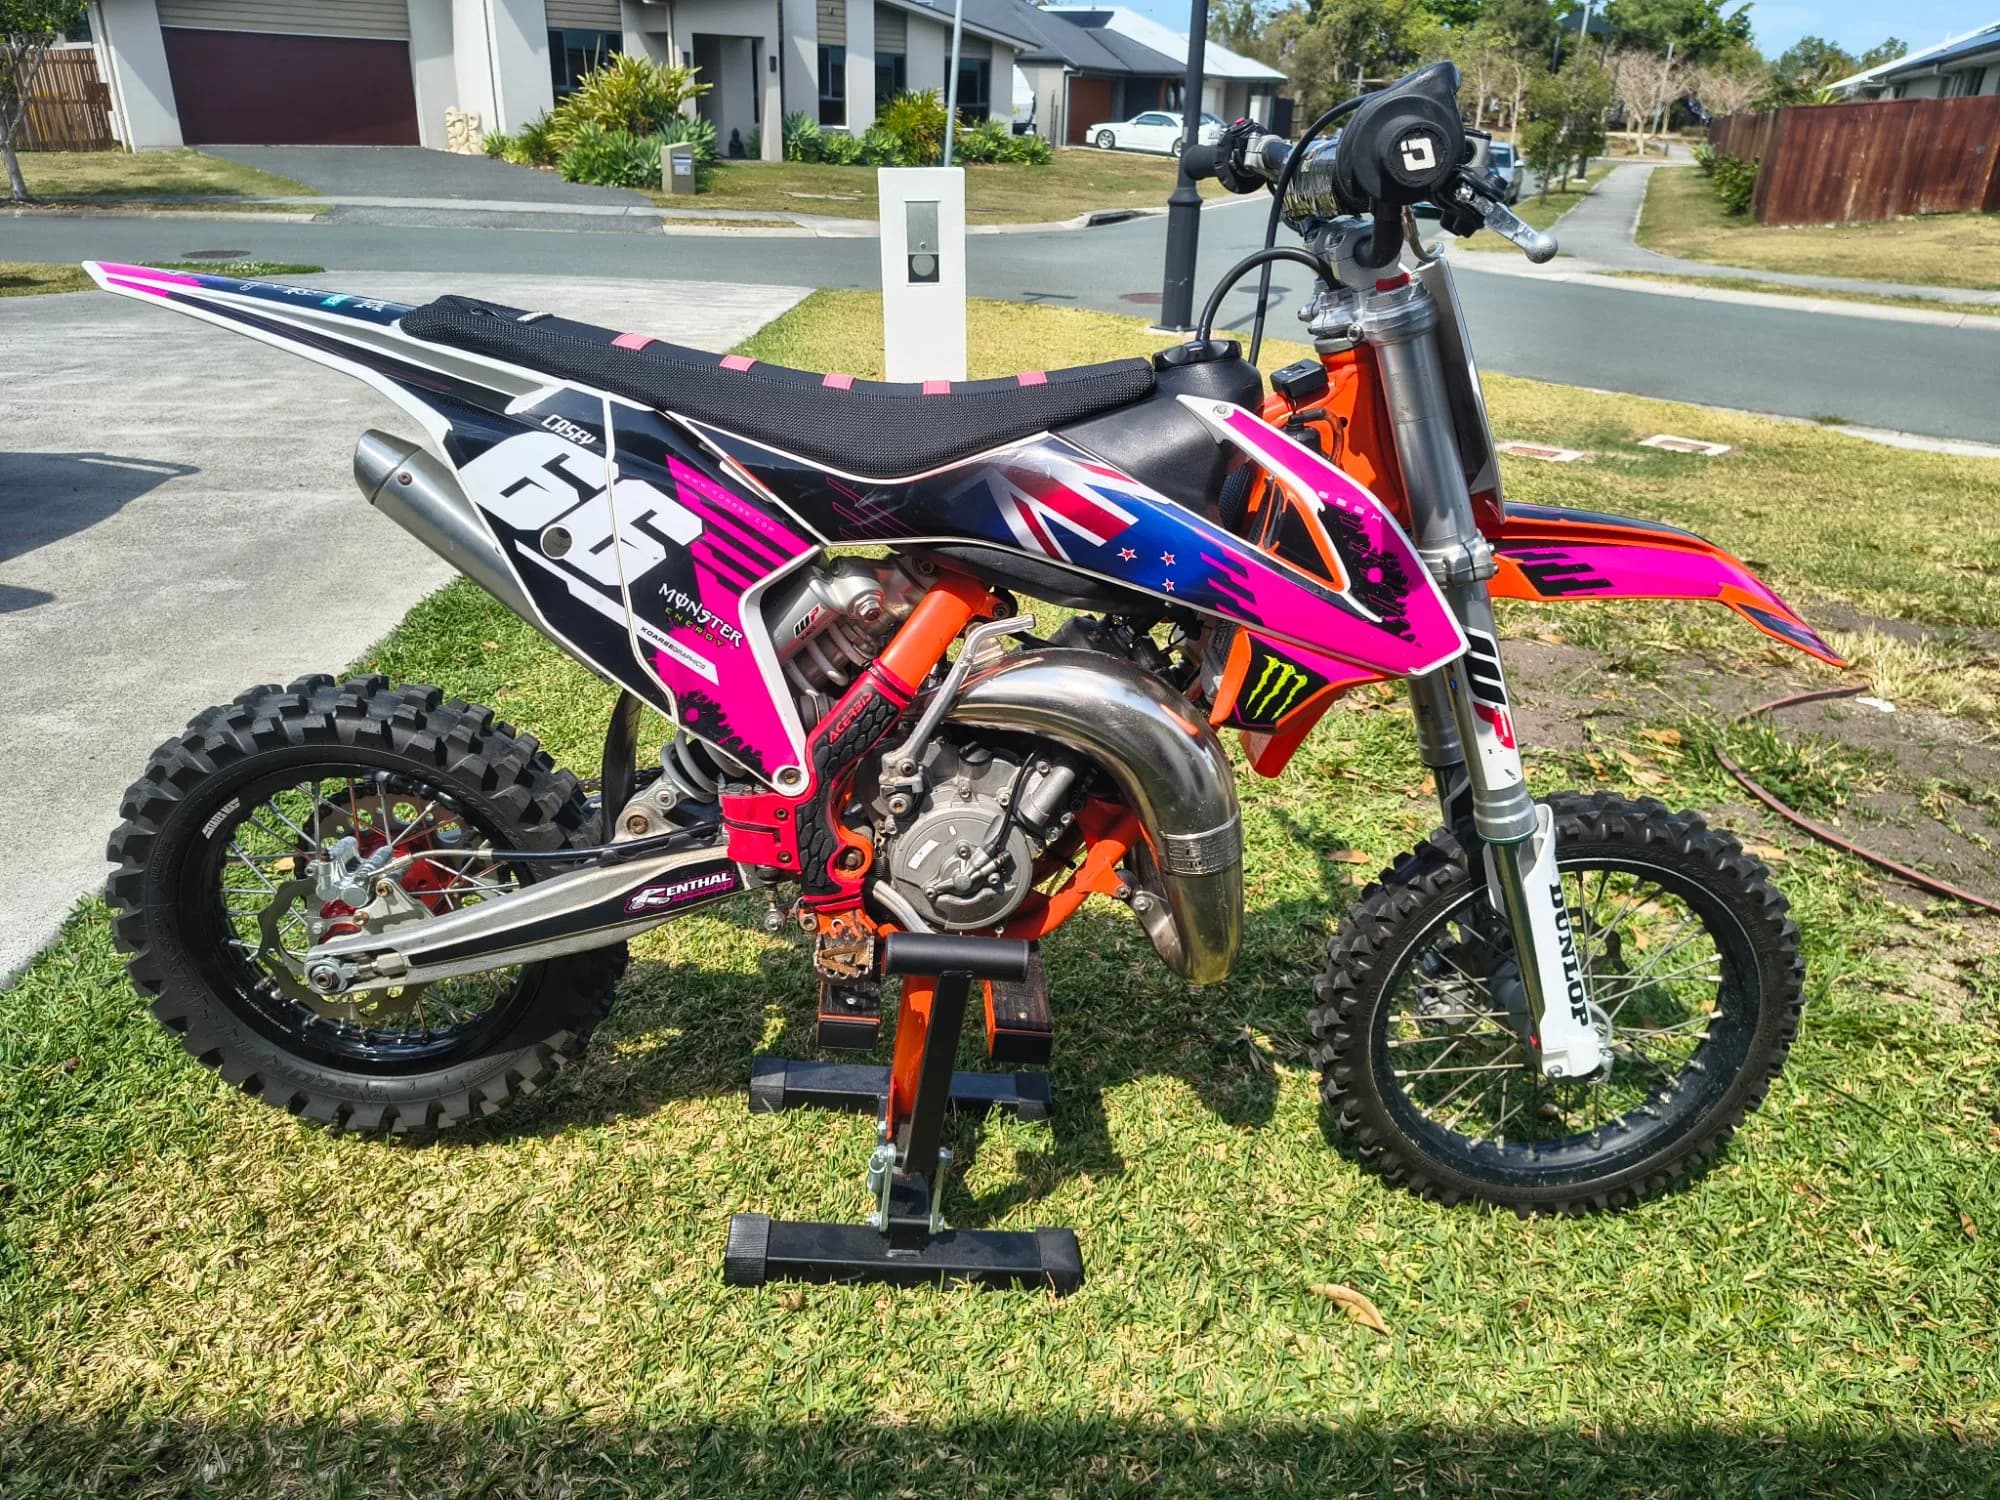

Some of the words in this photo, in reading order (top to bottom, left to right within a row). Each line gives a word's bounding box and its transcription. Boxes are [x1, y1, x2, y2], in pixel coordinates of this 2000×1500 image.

[541, 413, 597, 446] CASEY
[458, 430, 703, 587] 66
[658, 582, 743, 648] MONSTER
[664, 606, 727, 649] ENERGY
[829, 691, 873, 744] ACERBIS
[629, 873, 732, 911] RENTHAL
[1549, 883, 1589, 1026] DUNLOP
